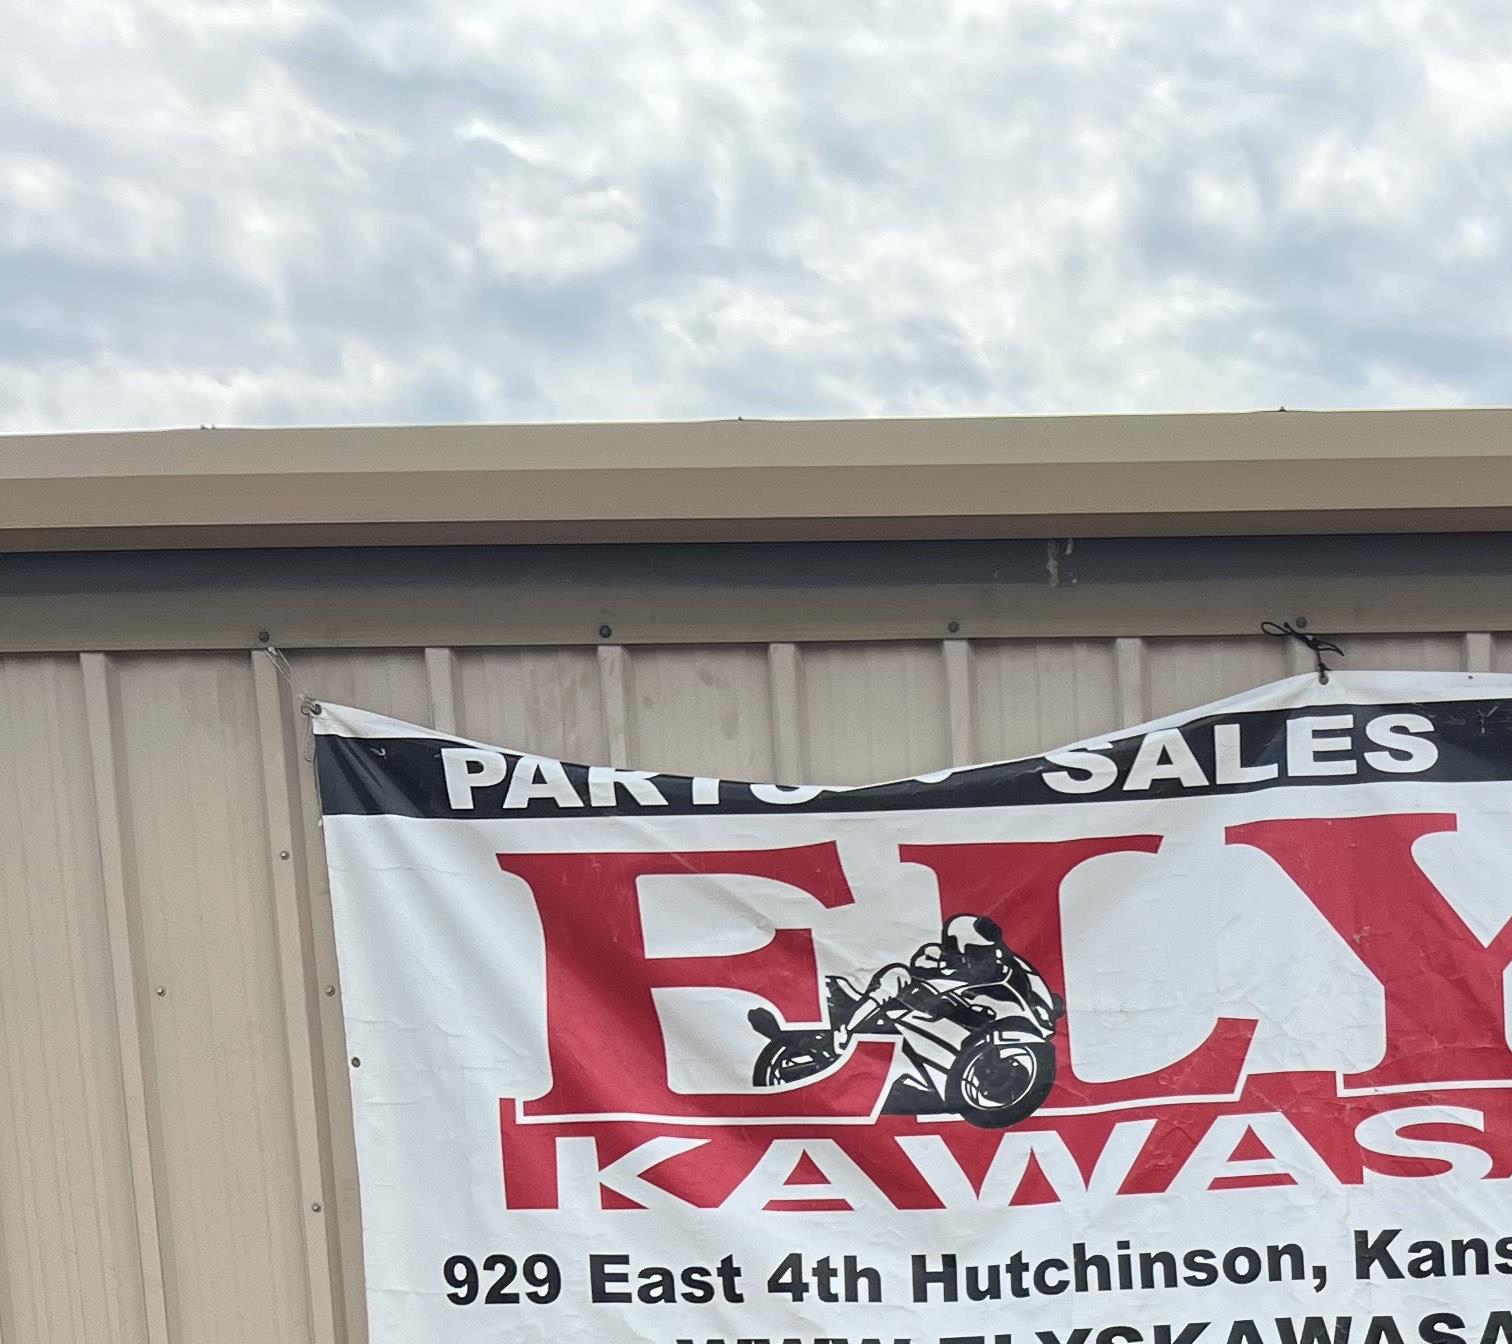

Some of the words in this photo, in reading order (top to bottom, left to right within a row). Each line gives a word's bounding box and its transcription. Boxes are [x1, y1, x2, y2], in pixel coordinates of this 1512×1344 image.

[440, 747, 823, 810] PAR
[1041, 713, 1439, 794] SALES
[443, 1253, 562, 1306] 929
[589, 1254, 745, 1304] East
[767, 1252, 882, 1303] 4th
[911, 1240, 1327, 1303] Hutchinson,
